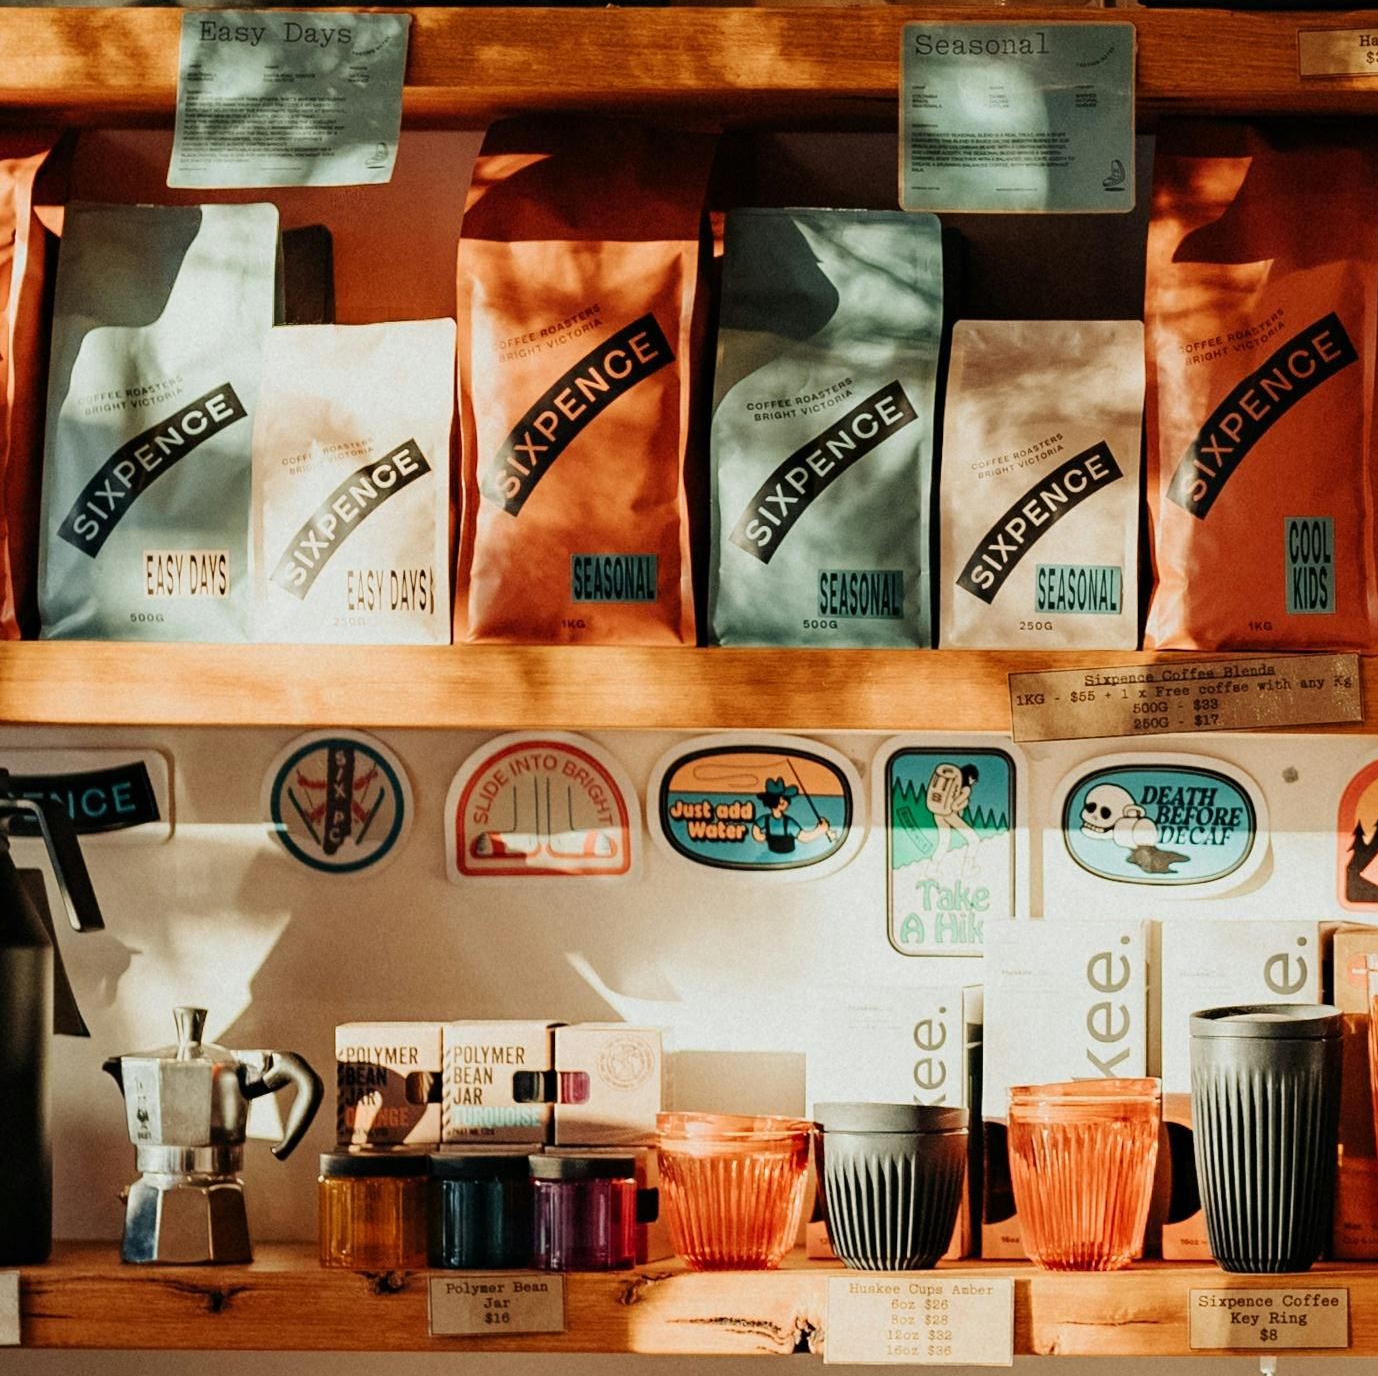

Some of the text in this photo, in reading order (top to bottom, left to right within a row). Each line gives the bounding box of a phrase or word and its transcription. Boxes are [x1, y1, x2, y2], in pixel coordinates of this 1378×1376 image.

[200, 21, 266, 46] Easy
[284, 22, 352, 48] Days
[915, 33, 1050, 55] Seasonal
[747, 377, 853, 411] COFFEE ROASTERS
[497, 332, 659, 498] SIXPENCE
[754, 390, 853, 421] BRIGHT VICTORIA
[1186, 330, 1342, 502] SIXPENCE
[971, 433, 1063, 471] COFFEE ROASTERS
[978, 444, 1063, 479] BRIGHT VICTORIA
[73, 393, 234, 541] SIXPENCE
[745, 396, 903, 547] SIXPENCE
[281, 449, 418, 587] SIXPENCE
[971, 455, 1110, 589] SIXPENCE
[1290, 521, 1331, 563] COOL
[147, 554, 227, 595] EASY DAYS
[573, 557, 655, 599] SEASONAL
[347, 570, 428, 611] EASY DAYS
[820, 573, 900, 615] SEASONAL
[1038, 569, 1117, 611] SEASONAL
[1293, 567, 1329, 609] KIDS
[130, 613, 165, 622] 500G
[562, 619, 586, 628] 1KG
[803, 620, 838, 629] 500G
[1019, 621, 1053, 631] 250G
[1248, 621, 1273, 630] 1KG
[1084, 663, 1275, 687] Sixpence Coffee Blends
[1016, 693, 1045, 706] 1KG
[1070, 690, 1096, 703] $55
[1138, 689, 1147, 699] x
[1154, 685, 1190, 698] Free
[1199, 681, 1249, 695] coffee
[1258, 677, 1291, 692] with
[1300, 678, 1325, 691] any
[1132, 702, 1168, 714] 500G
[1133, 714, 1220, 730] 250G $17
[474, 754, 614, 825] SLIDE INTO BRIGHT
[1140, 786, 1217, 807] DEATH
[670, 800, 756, 821] Just add
[1155, 805, 1244, 826] BEFORE
[687, 820, 748, 842] Water
[1158, 825, 1234, 845] DECAF
[916, 880, 990, 911] Take
[347, 1047, 418, 1064] POLYMER
[453, 1046, 525, 1064] POLYMER
[453, 1067, 493, 1084] BEAN
[453, 1087, 482, 1105] JAR
[453, 1107, 541, 1127] TURQUOISE
[447, 1282, 548, 1296] Polymer Bean
[849, 1284, 994, 1296] Huskee Cups Amber
[484, 1298, 511, 1308] Jar
[891, 1299, 949, 1310] 6oz $26
[1198, 1294, 1339, 1309] Sixpence Coffee
[891, 1314, 949, 1326] 8oz $28
[1230, 1312, 1308, 1326] Key Ring
[887, 1330, 953, 1341] 12oz $32
[1260, 1329, 1278, 1342] $8
[887, 1345, 953, 1356] 16oz $36
